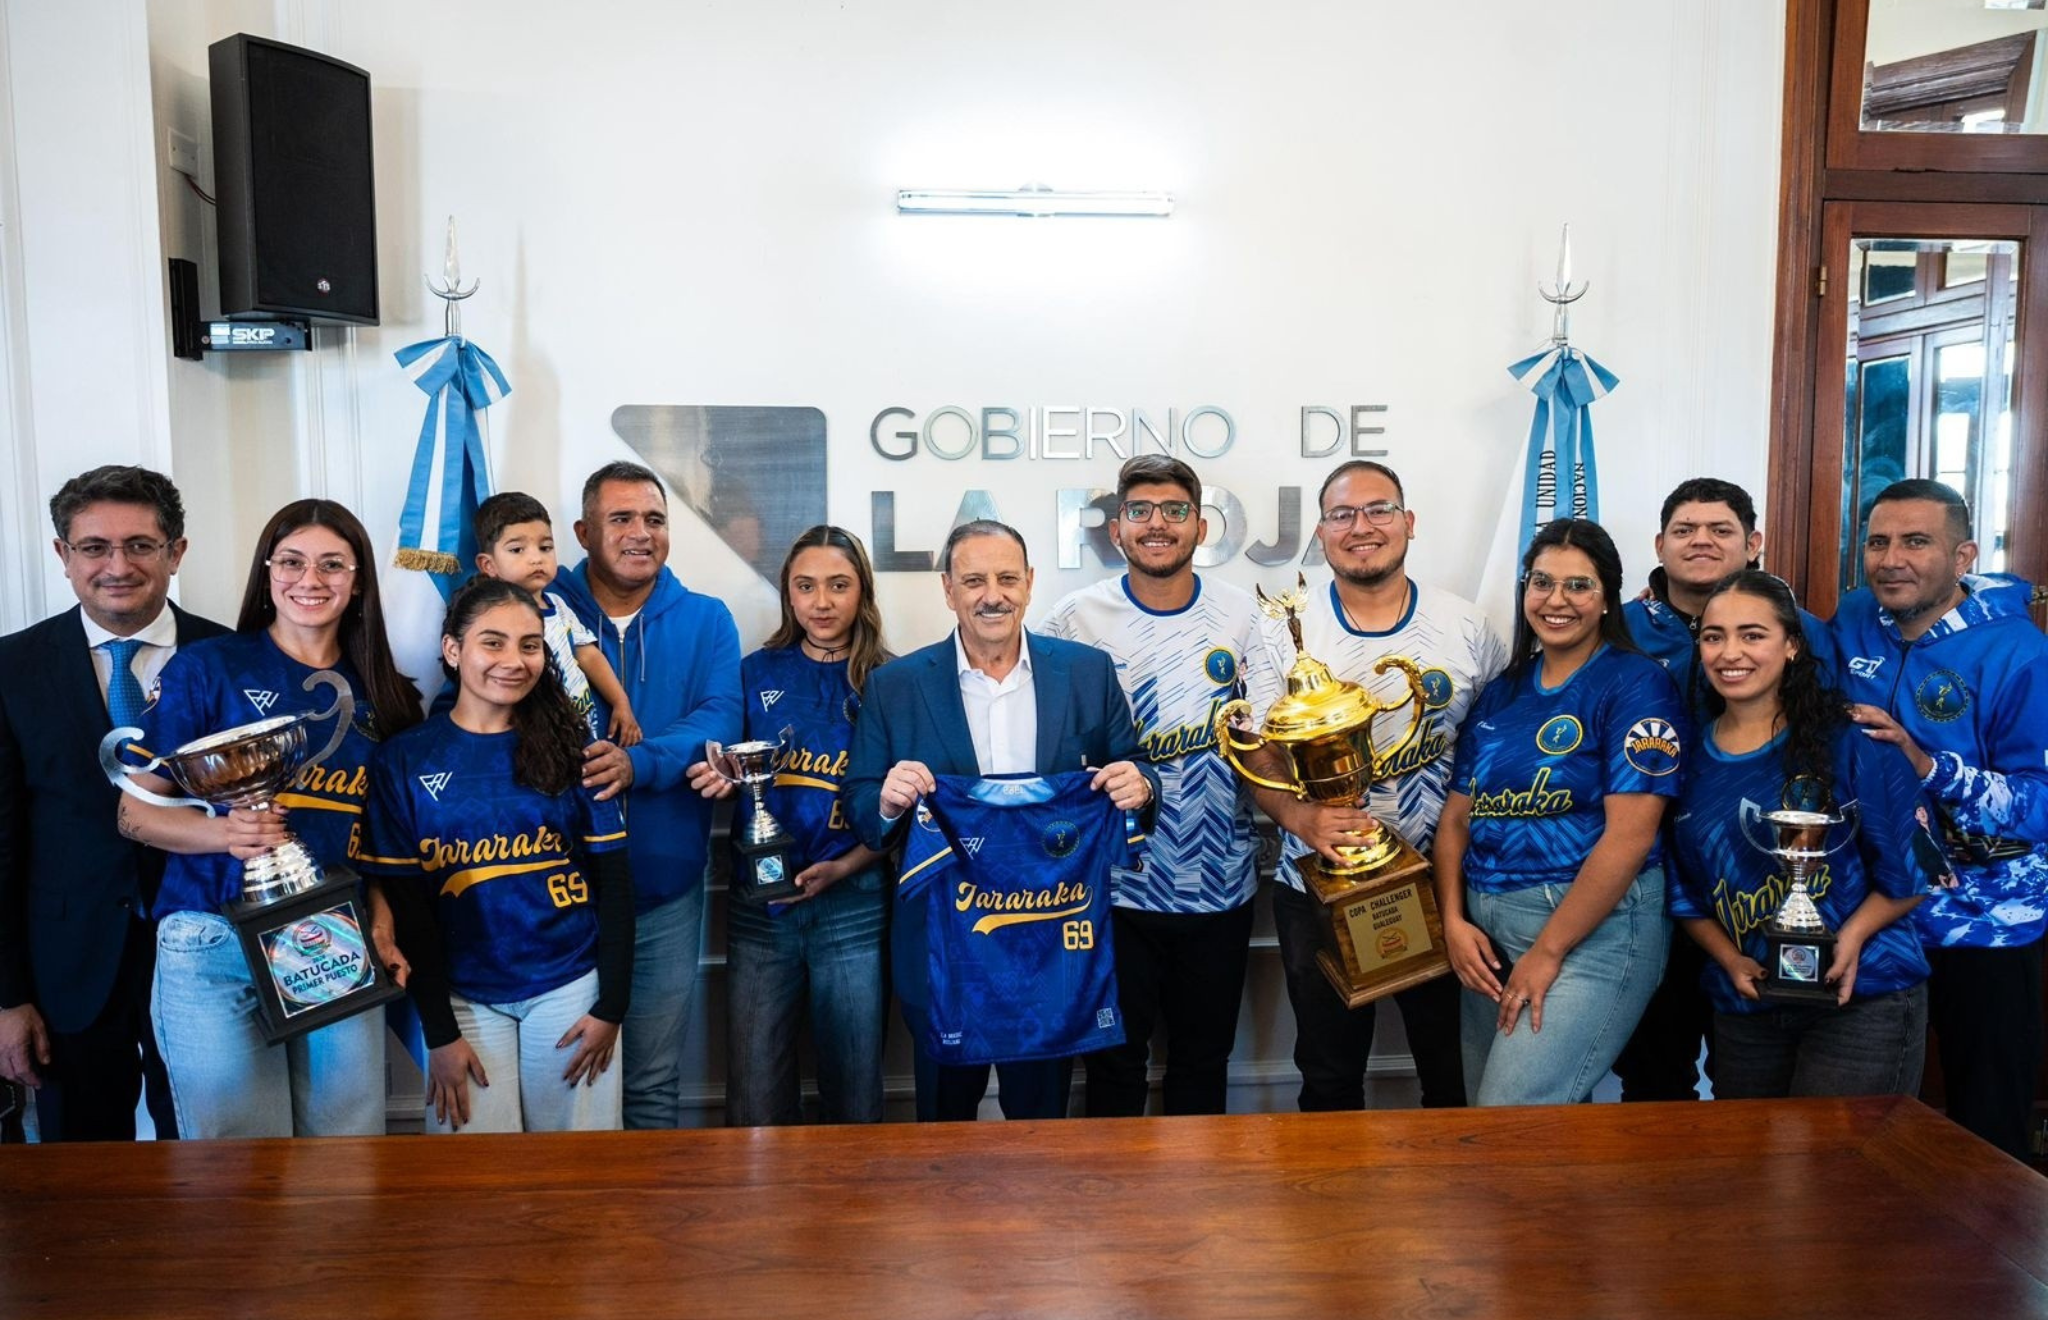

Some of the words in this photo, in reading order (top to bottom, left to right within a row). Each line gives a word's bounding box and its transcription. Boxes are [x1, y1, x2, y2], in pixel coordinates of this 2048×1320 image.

[870, 404, 1236, 460] GOBIERNO
[1301, 405, 1389, 459] DE
[1536, 450, 1557, 508] UNIDAD
[1572, 462, 1588, 520] NACION
[955, 881, 1092, 911] Jararaka
[1348, 905, 1366, 918] COPA
[1370, 888, 1412, 910] CHALLENGER
[1372, 906, 1398, 920] BATUCADA
[1372, 914, 1402, 930] GUALEGUAY
[1062, 920, 1094, 950] 69
[283, 951, 361, 987] BATUCADA
[292, 977, 325, 994] PRIMER
[325, 964, 358, 982] PUESTO
